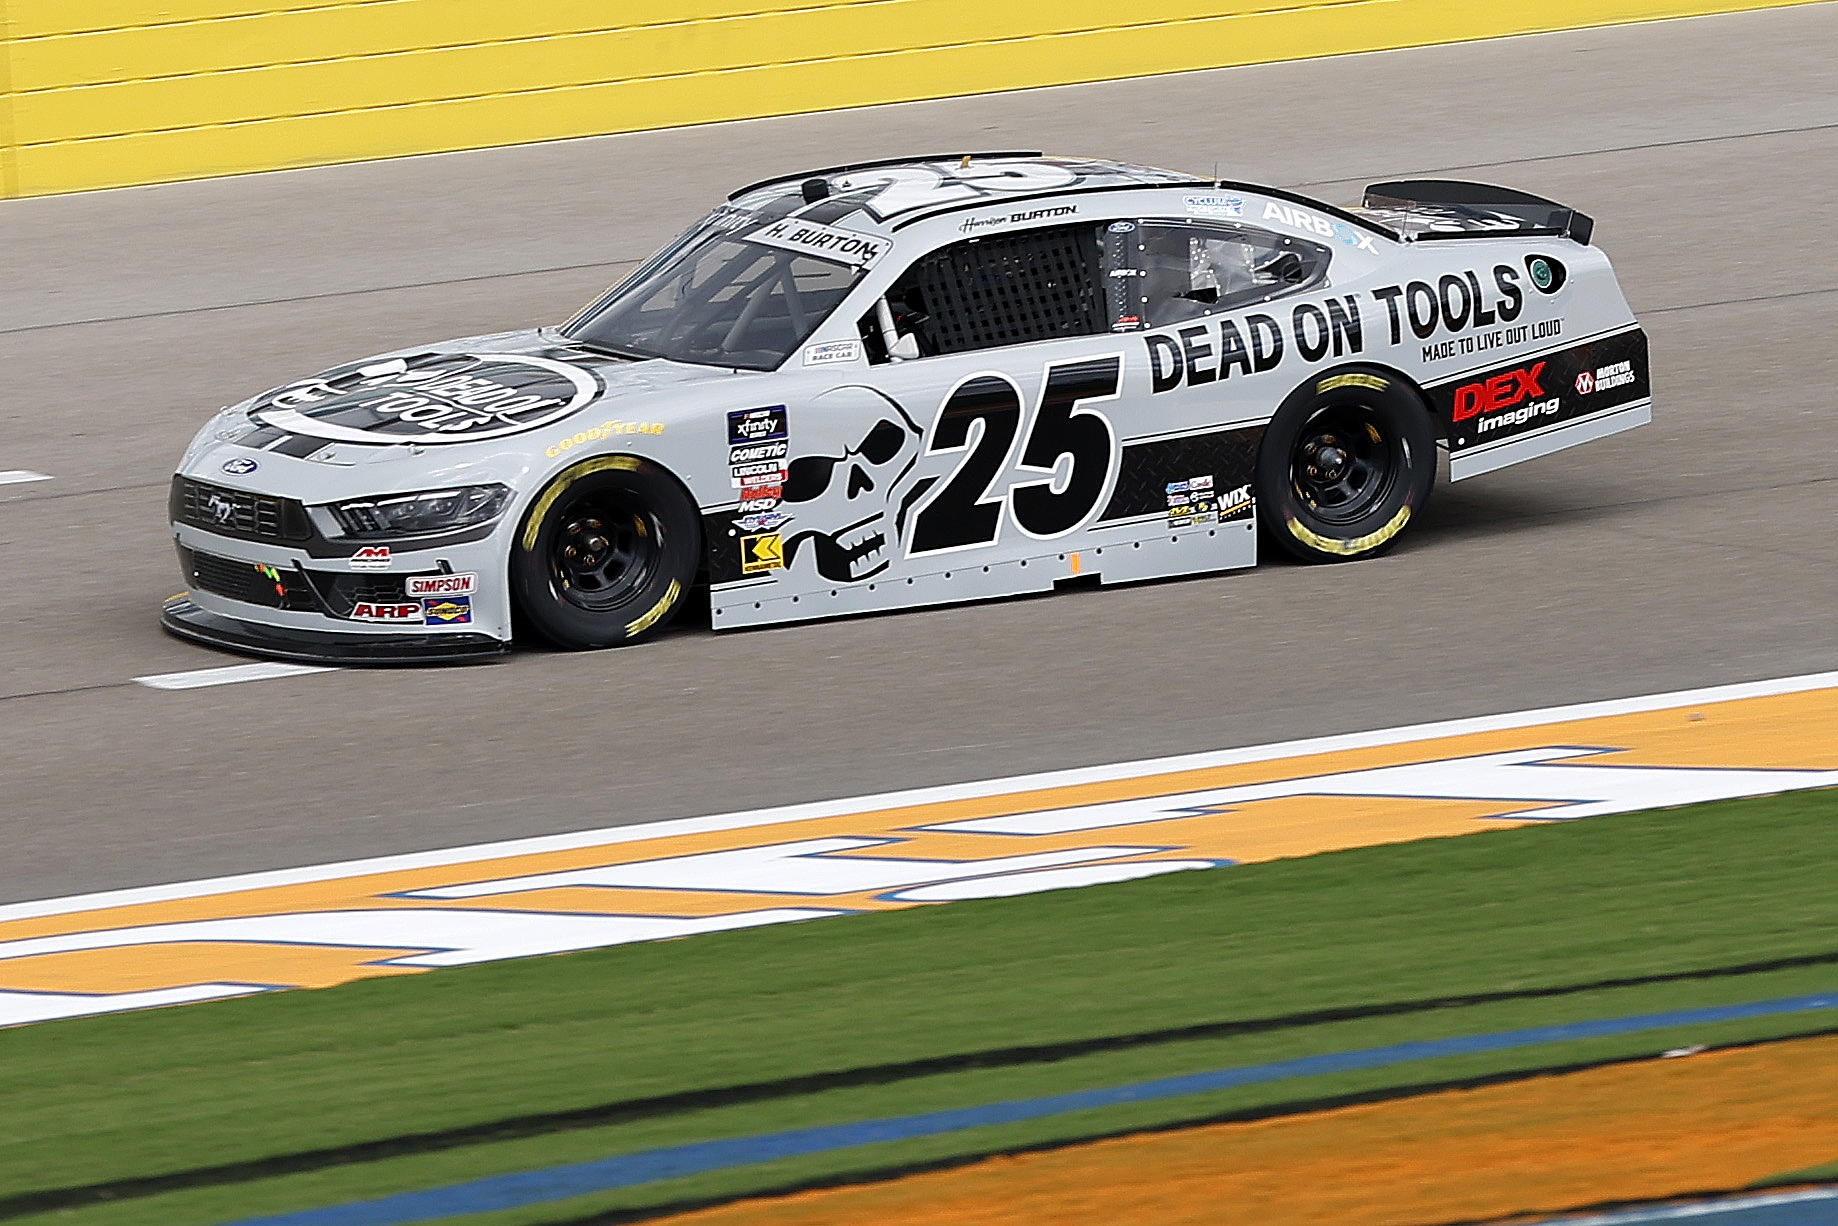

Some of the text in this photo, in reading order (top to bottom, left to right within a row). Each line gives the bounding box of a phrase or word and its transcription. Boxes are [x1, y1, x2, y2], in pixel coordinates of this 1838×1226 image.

[1010, 204, 1078, 223] BURTON
[1262, 201, 1380, 256] AIRBOX
[764, 222, 879, 258] H. BURTON
[1144, 264, 1524, 394] DEAD ON TOOLS
[1422, 340, 1456, 363] MADE
[1458, 338, 1474, 354] TO
[1477, 330, 1503, 352] LIVE
[1506, 325, 1529, 346] OUT
[1594, 370, 1636, 393] BUILDINGS
[1596, 360, 1631, 380] MORTON
[412, 375, 518, 405] DEAD
[1452, 361, 1547, 423] DEX
[357, 390, 492, 432] TOOLS
[1477, 397, 1560, 434] imaging
[545, 419, 666, 459] GOODYEAR
[737, 418, 778, 437] xfinity
[733, 463, 778, 477] LINCOLN
[905, 351, 1125, 560] 25
[738, 498, 777, 513] MSD
[1217, 483, 1252, 511] WIX
[411, 576, 472, 593] SIMPSON
[353, 603, 421, 619] ARP
